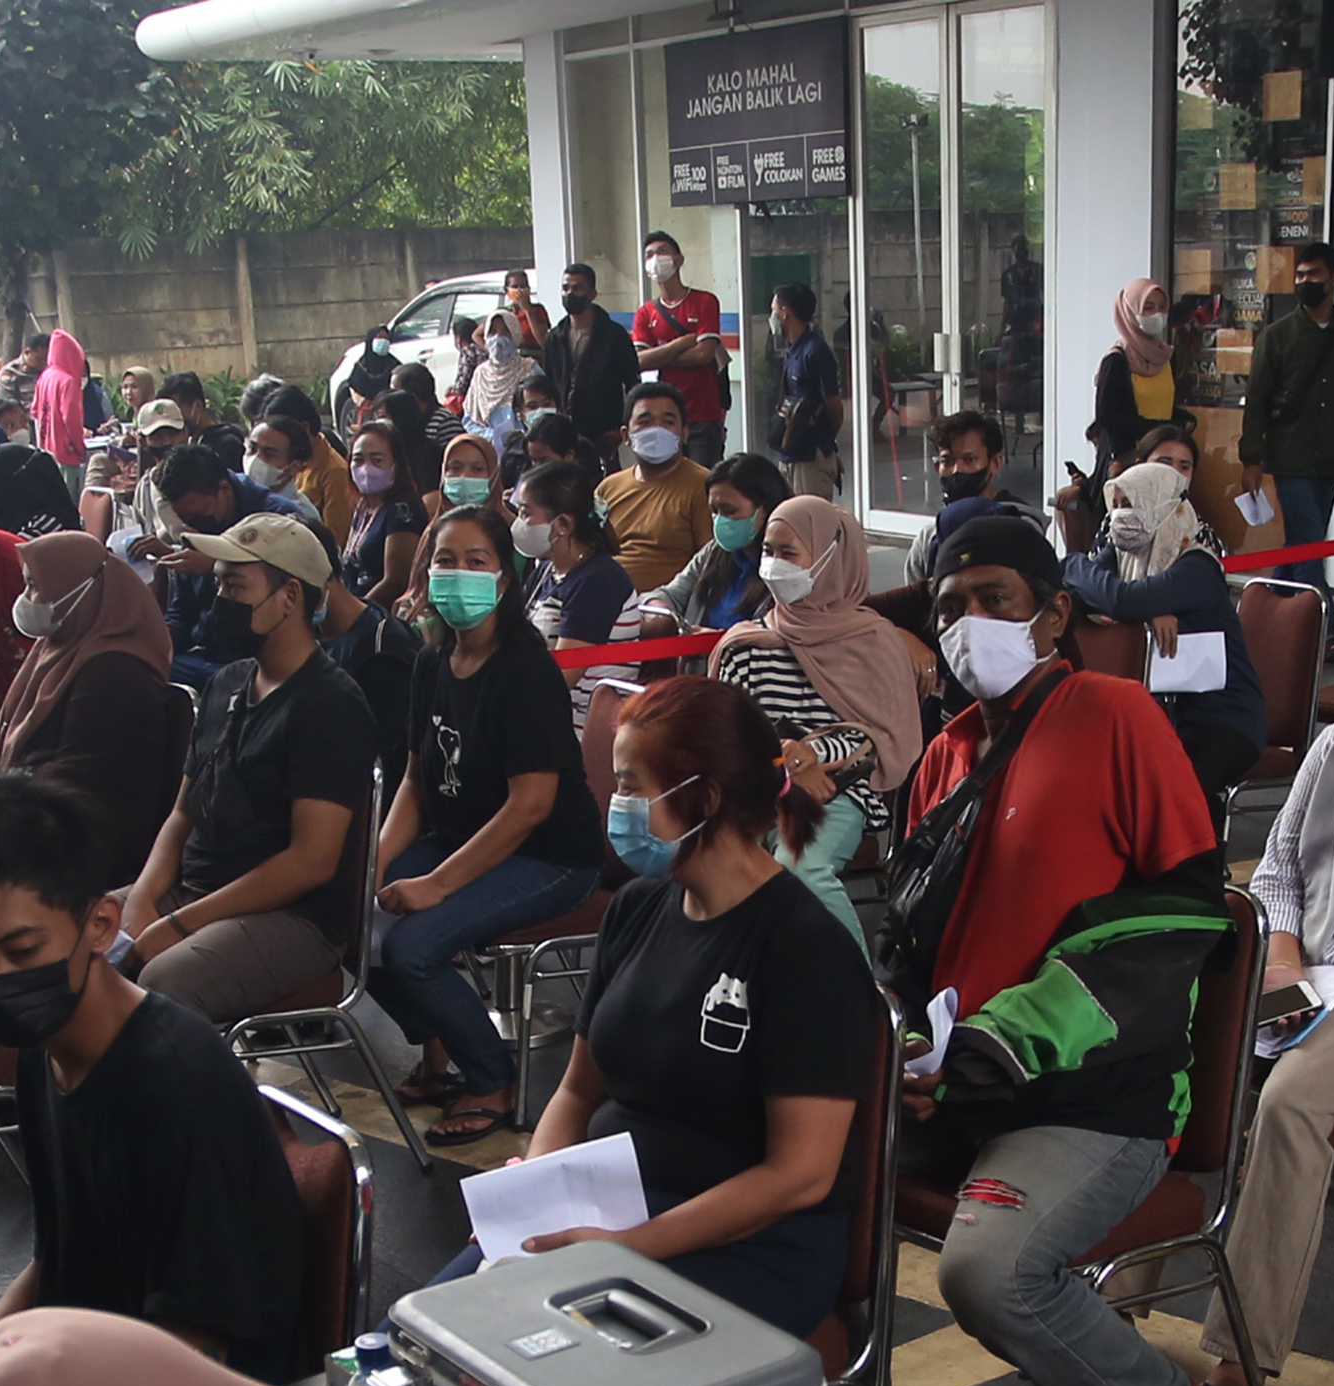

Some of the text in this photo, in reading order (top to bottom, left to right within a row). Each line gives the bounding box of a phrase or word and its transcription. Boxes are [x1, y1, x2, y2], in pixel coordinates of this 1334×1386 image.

[707, 63, 797, 94] KALO MAHAL
[686, 81, 822, 119] JANGAN BALIK LAGI
[764, 152, 785, 168] FREE
[812, 147, 835, 165] FREE
[674, 163, 690, 178] FREE
[764, 168, 803, 184] COLOKAN
[812, 166, 846, 183] GAMES
[727, 175, 746, 189] FILM
